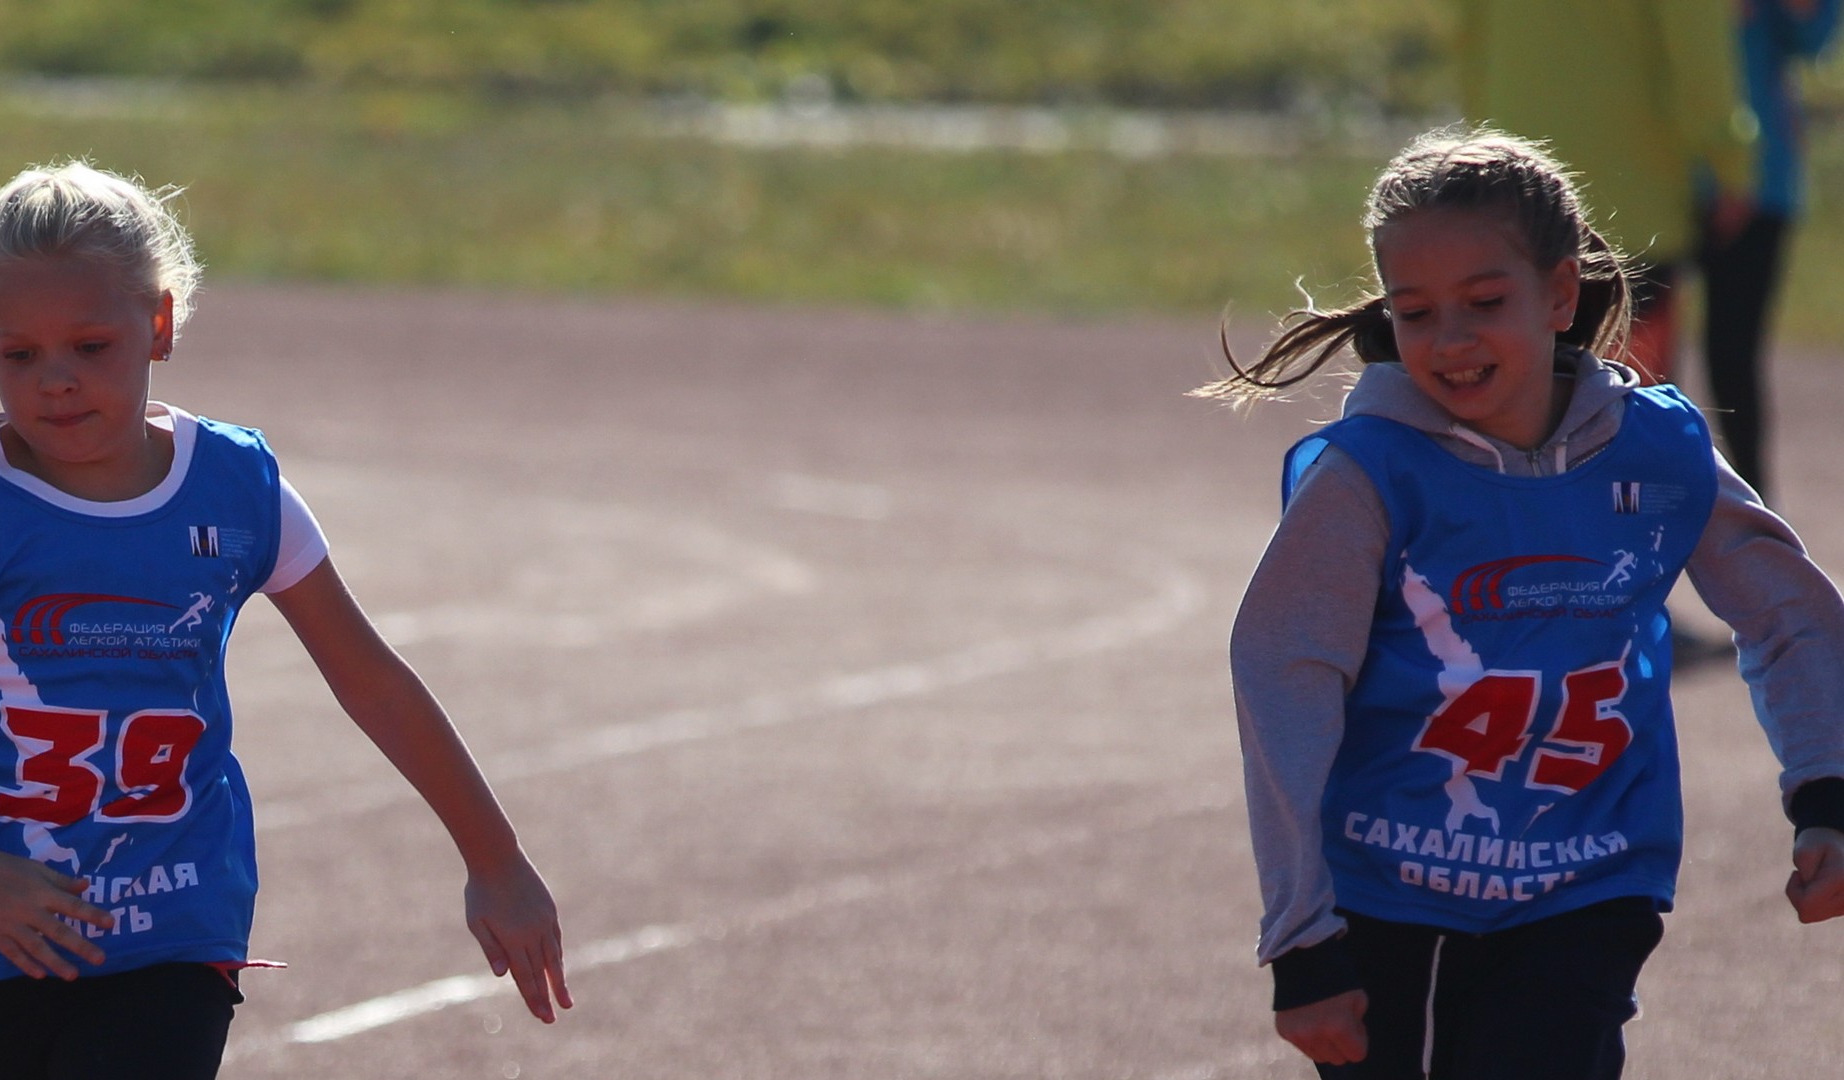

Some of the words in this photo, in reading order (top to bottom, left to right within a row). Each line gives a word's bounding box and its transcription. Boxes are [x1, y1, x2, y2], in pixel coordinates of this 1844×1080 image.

[1507, 581, 1600, 597] ФЕДЕРАЦИЯ
[69, 622, 166, 634] ФЕДЕРАЦИЯ
[67, 634, 128, 646] ЛЕГКОЙ
[1411, 660, 1634, 796] 45
[1344, 811, 1629, 870] САХАЛИНСКАЯ
